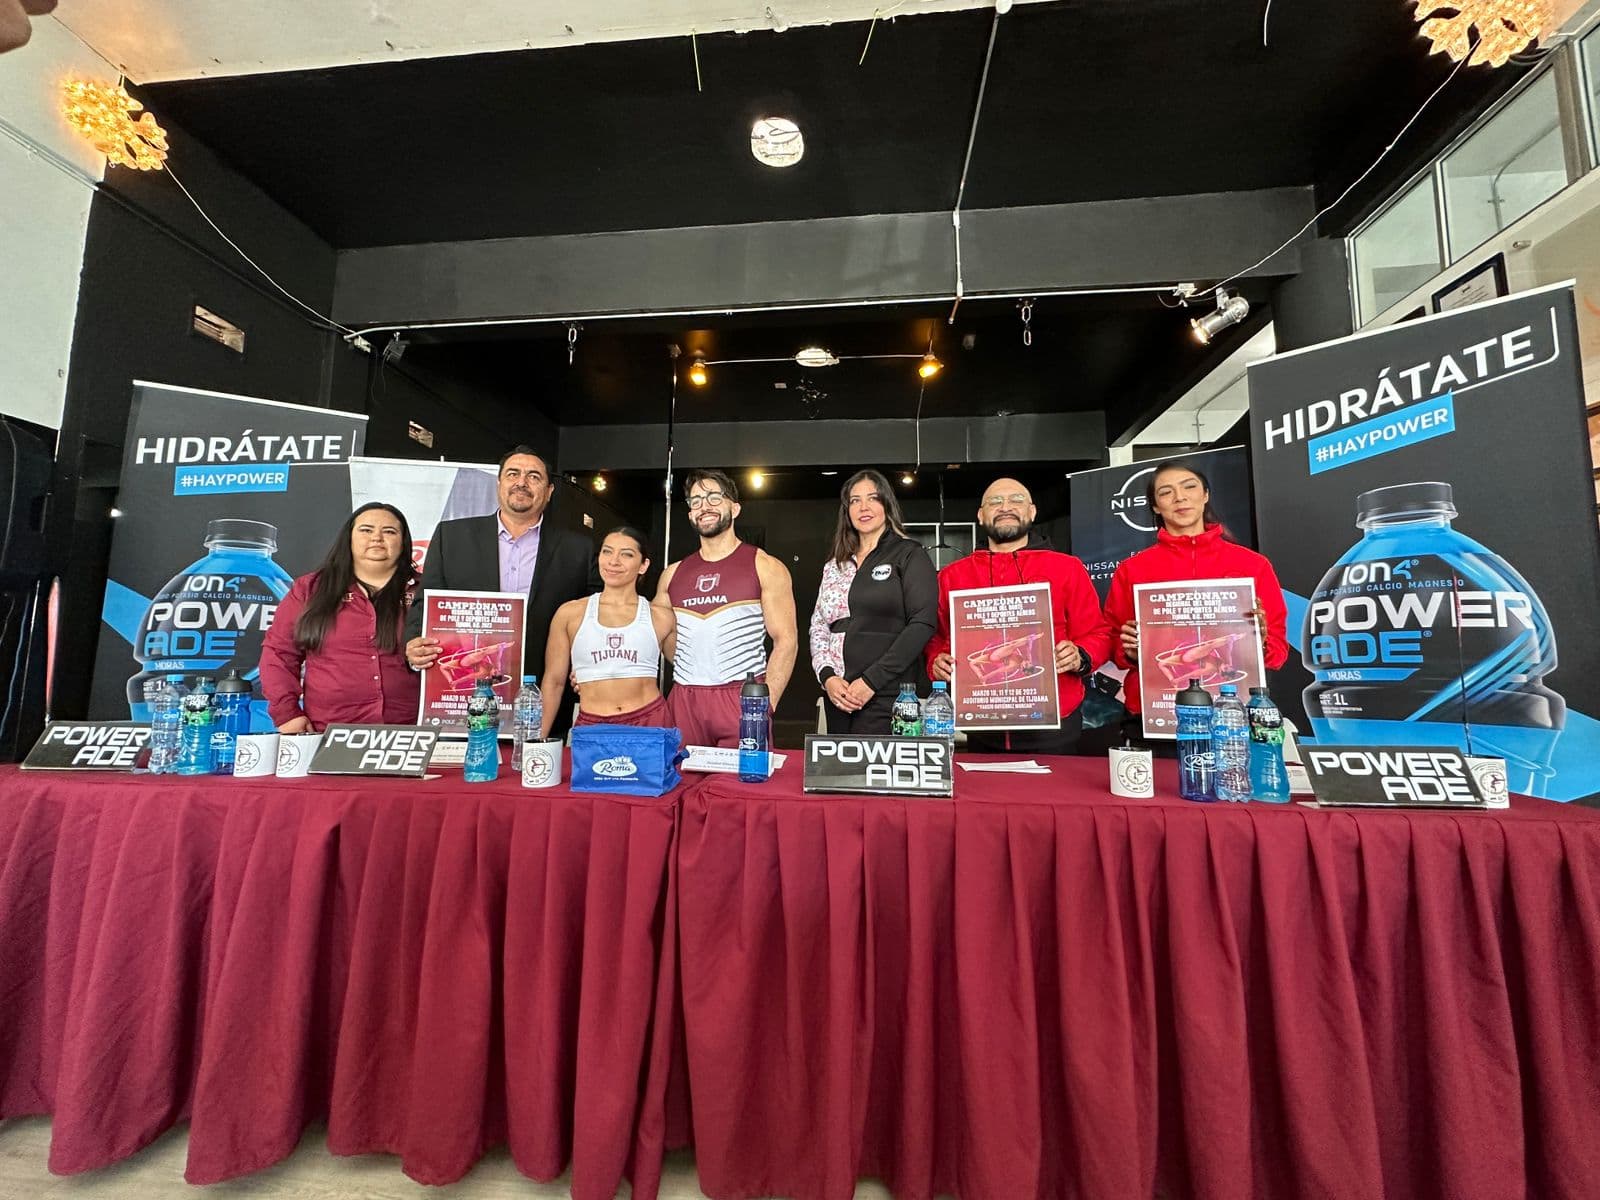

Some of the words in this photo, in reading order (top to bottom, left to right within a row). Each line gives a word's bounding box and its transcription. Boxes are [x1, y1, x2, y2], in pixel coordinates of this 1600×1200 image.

[1264, 325, 1534, 451] HIDRÁTATE
[1315, 407, 1449, 463] #HAYPOWER
[136, 429, 342, 464] HIDRÁTATE
[180, 472, 285, 488] #HAYPOWER
[1111, 495, 1148, 510] NIS
[1366, 583, 1402, 592] CALCIO
[1408, 579, 1465, 588] MAGNESO
[235, 594, 273, 602] MAGNESIO
[438, 601, 512, 611] CAMPEONATO
[682, 595, 728, 607] TIJUANA
[963, 595, 1036, 608] CAMPEONATO
[1149, 591, 1238, 603] CAMPEONATO
[147, 602, 279, 631] POWE
[1310, 591, 1536, 634] POWER
[144, 631, 238, 656] ADE
[1311, 631, 1424, 665] ADE
[591, 649, 638, 664] TIJUANA
[1327, 670, 1362, 680] MORAS
[1333, 692, 1349, 705] 1L
[42, 726, 153, 747] POWER
[325, 729, 436, 750] POWER
[72, 746, 140, 765] ADE
[359, 750, 426, 771] ADE
[812, 741, 945, 765] POWER
[1309, 751, 1466, 776] POWER
[600, 761, 632, 773] Roma
[865, 764, 943, 788] ADE
[1381, 777, 1476, 802] ADE
